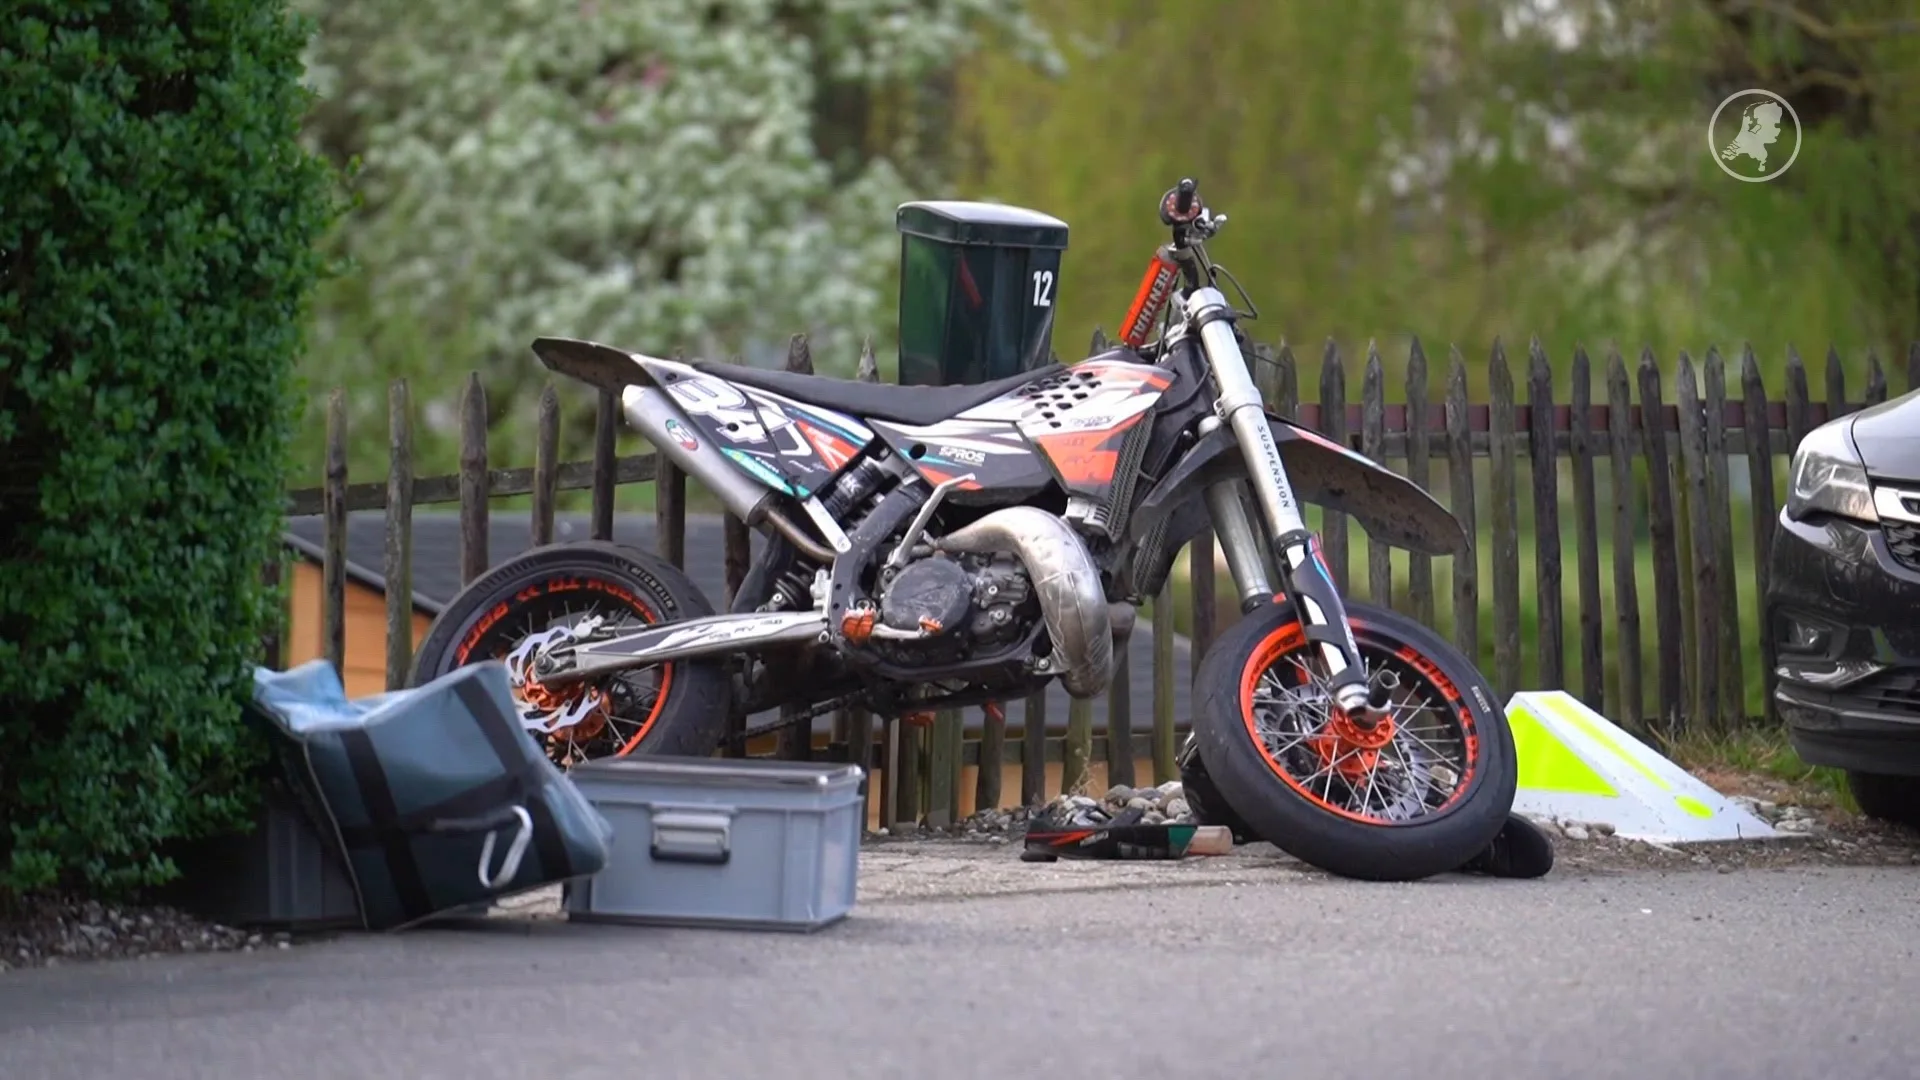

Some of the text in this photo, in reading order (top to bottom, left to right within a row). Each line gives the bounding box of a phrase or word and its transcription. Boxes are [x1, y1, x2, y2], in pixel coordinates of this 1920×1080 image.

[1033, 270, 1053, 307] 12
[1129, 267, 1171, 340] RENTHAL
[1257, 425, 1290, 508] SUSPENSION
[630, 566, 675, 610] MICHELIN
